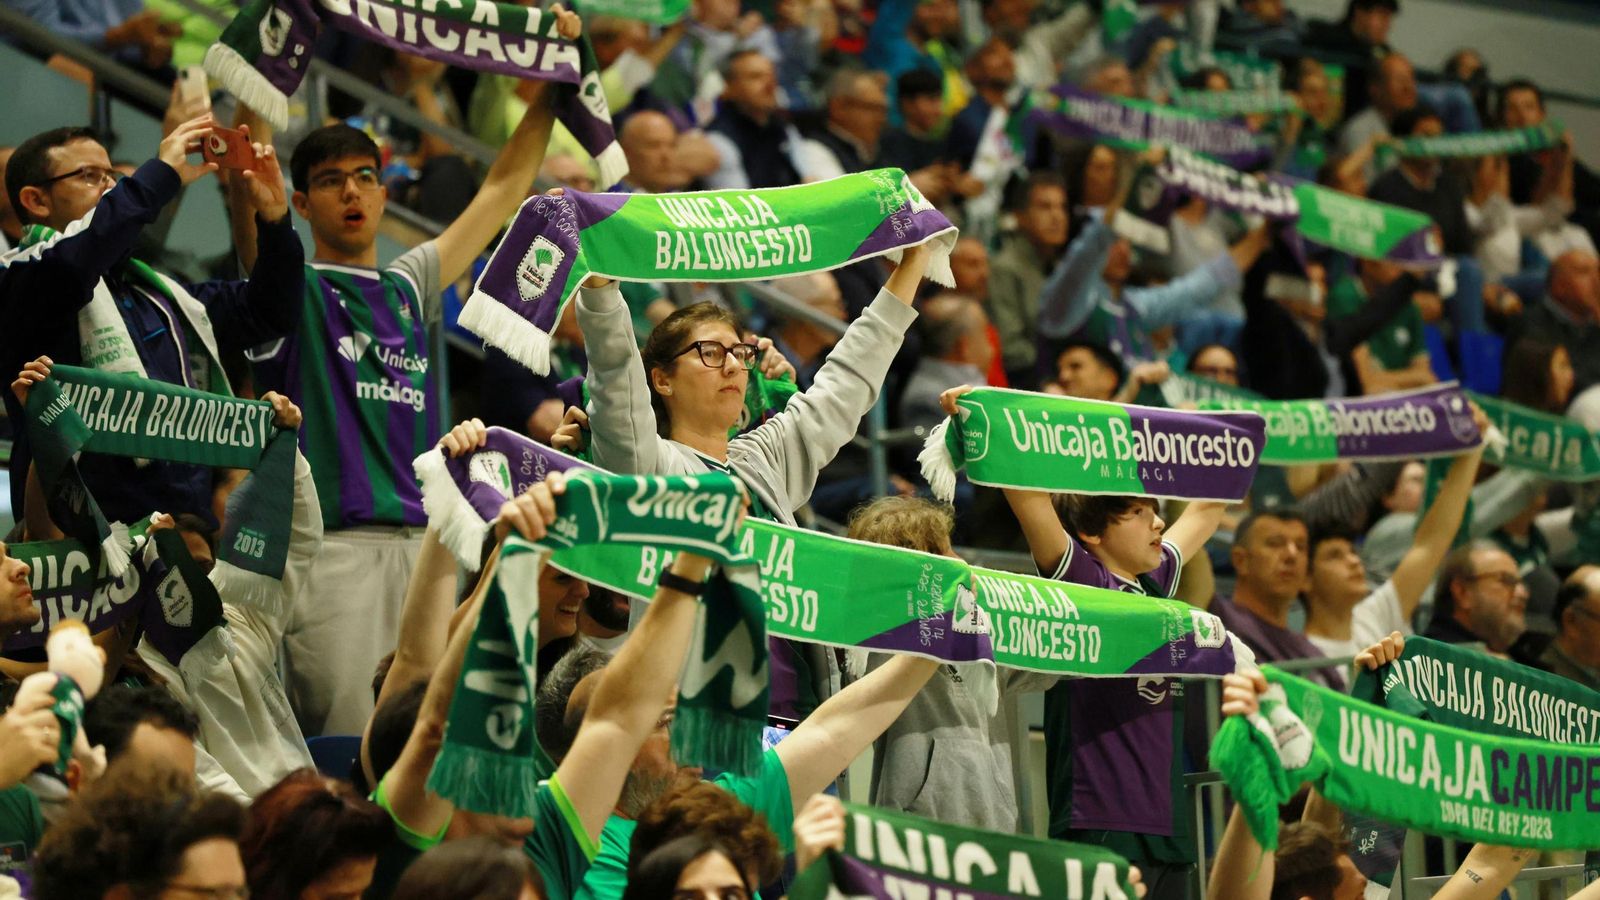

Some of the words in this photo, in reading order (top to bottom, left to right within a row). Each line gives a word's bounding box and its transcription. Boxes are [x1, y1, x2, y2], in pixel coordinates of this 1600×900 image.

[318, 0, 581, 71] NICAJA
[656, 195, 780, 229] UNICAJA
[655, 224, 812, 270] BALONCESTO
[55, 380, 145, 434] NICAJA
[1309, 400, 1436, 437] Baloncesto
[1004, 407, 1112, 471] Unicaja
[1109, 416, 1256, 468] Baloncesto
[233, 531, 266, 558] 2013
[927, 572, 945, 621] bandera
[975, 574, 1081, 620] UNICAJA
[916, 599, 932, 648] siempre
[931, 627, 945, 640] tu
[985, 611, 1101, 664] ALONCESTO
[1493, 676, 1600, 745] BALONCEST
[1338, 707, 1491, 802] UNICAJA
[1440, 799, 1470, 829] COPA
[1472, 806, 1494, 833] DEL
[1497, 810, 1520, 836] REY
[1521, 814, 1553, 840] 2023
